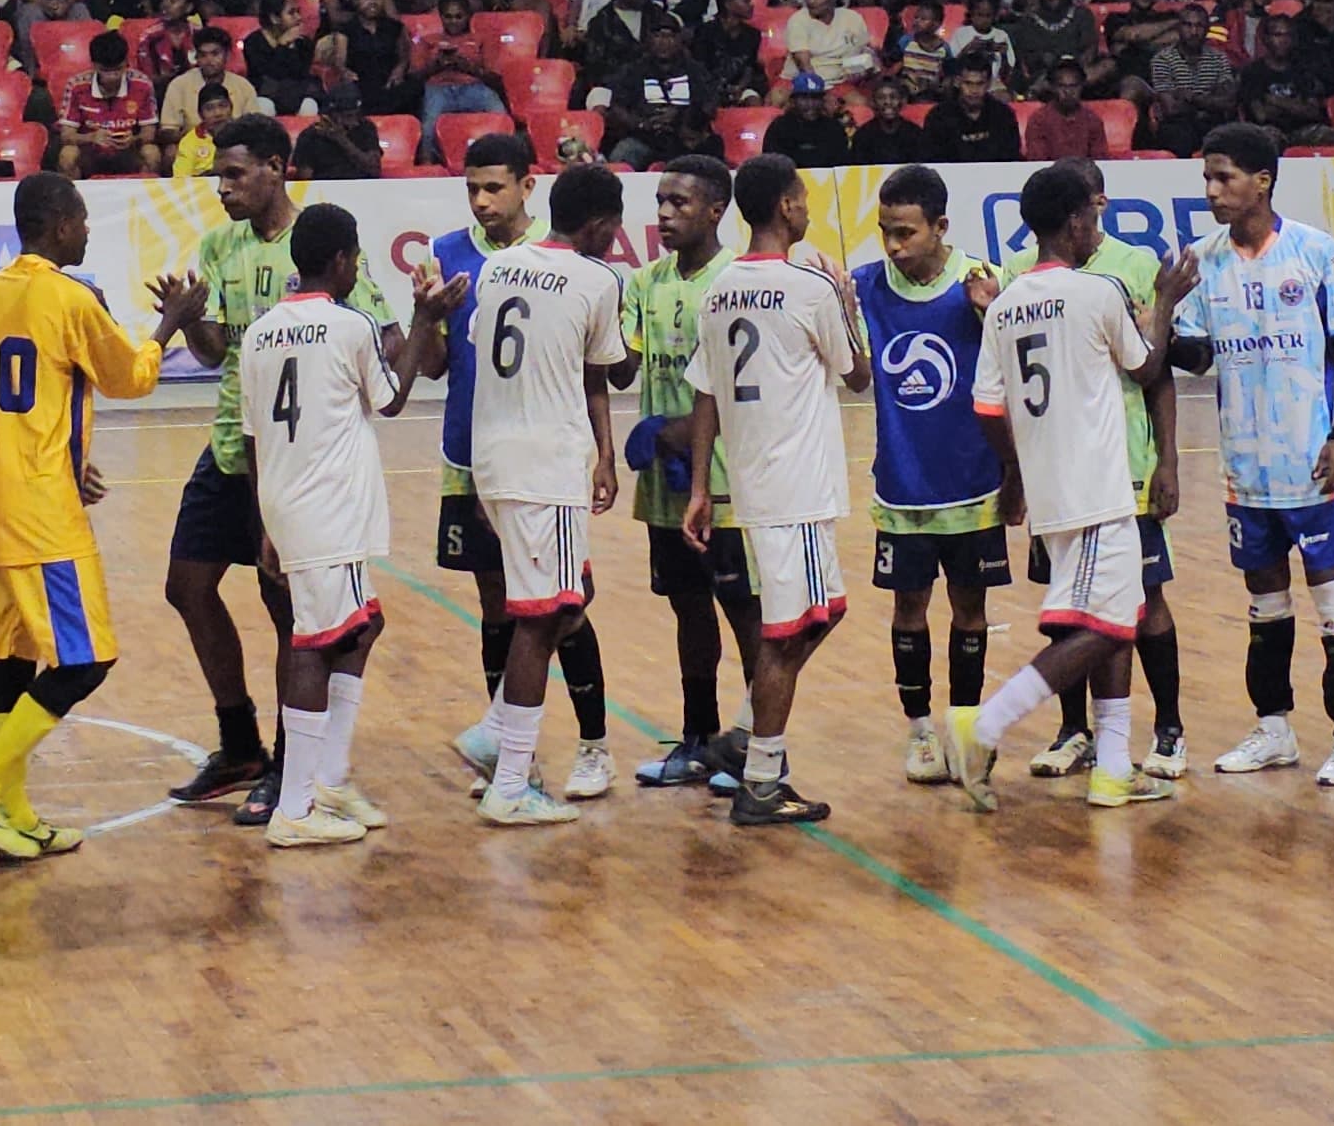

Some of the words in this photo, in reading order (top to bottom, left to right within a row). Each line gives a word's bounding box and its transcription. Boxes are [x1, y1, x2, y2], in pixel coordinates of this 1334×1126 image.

[255, 265, 273, 297] 10
[489, 265, 568, 295] SMANKOR
[1243, 281, 1265, 310] 13
[673, 299, 684, 329] 2
[710, 289, 786, 314] SMANKOR
[997, 298, 1066, 331] SMANKOR
[255, 324, 328, 352] SMANKOR
[491, 296, 532, 380] 6
[727, 316, 762, 403] 2
[1015, 333, 1051, 418] 5
[272, 356, 302, 443] 4
[875, 539, 894, 574] 3
